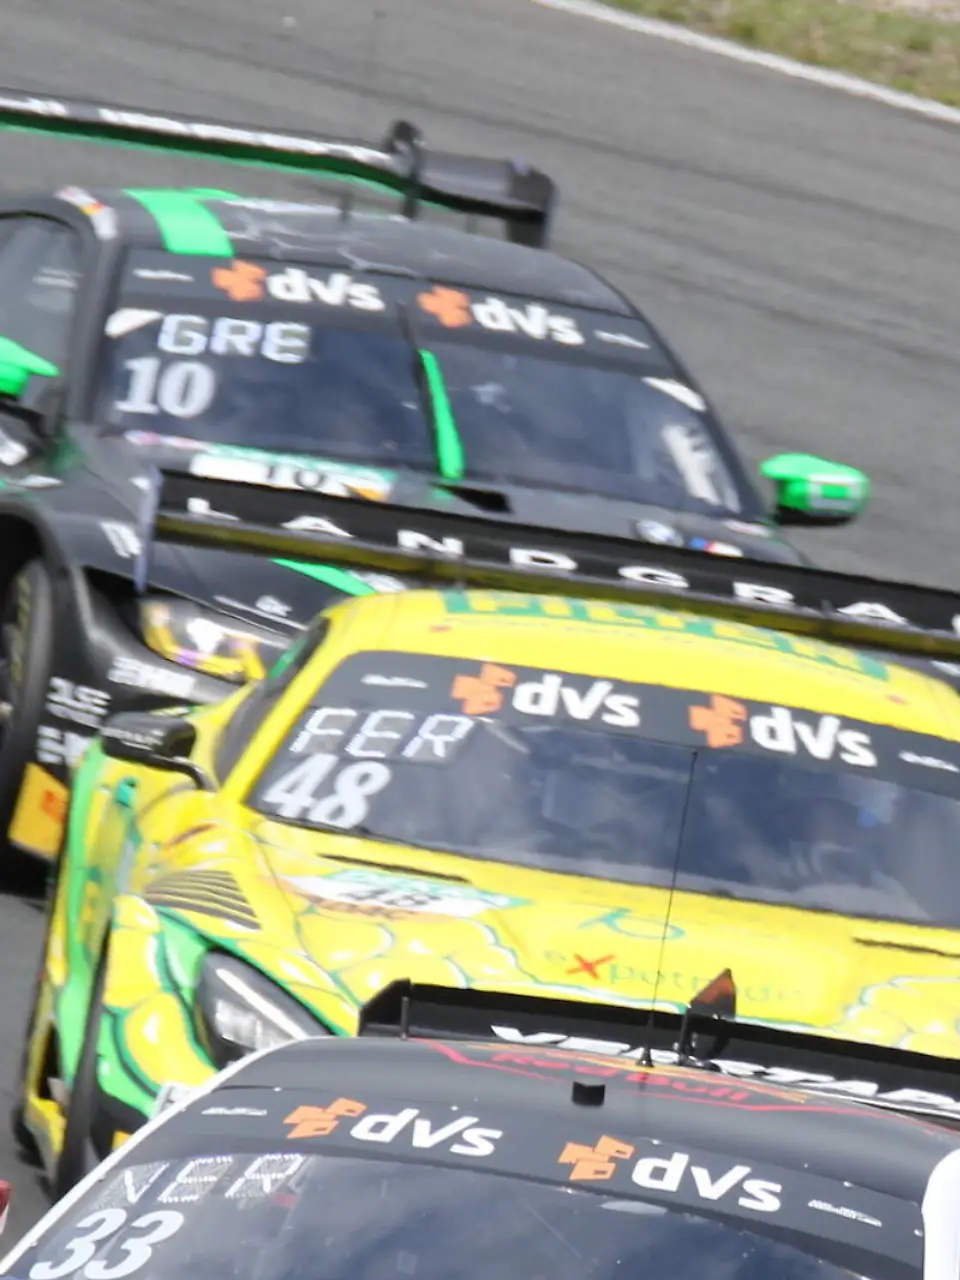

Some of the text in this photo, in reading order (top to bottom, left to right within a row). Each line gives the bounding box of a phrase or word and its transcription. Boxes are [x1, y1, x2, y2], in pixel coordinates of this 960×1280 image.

[266, 268, 385, 311] dvs
[157, 314, 311, 365] GRE
[470, 297, 585, 346] dvs
[114, 357, 215, 418] 10
[512, 674, 641, 727] dvs
[289, 707, 475, 760] FER
[750, 706, 877, 768] dvs
[260, 753, 391, 829] 48
[350, 1108, 504, 1157] dvs
[123, 1153, 305, 1204] VER
[632, 1152, 782, 1212] dvs
[29, 1208, 185, 1280] 33
